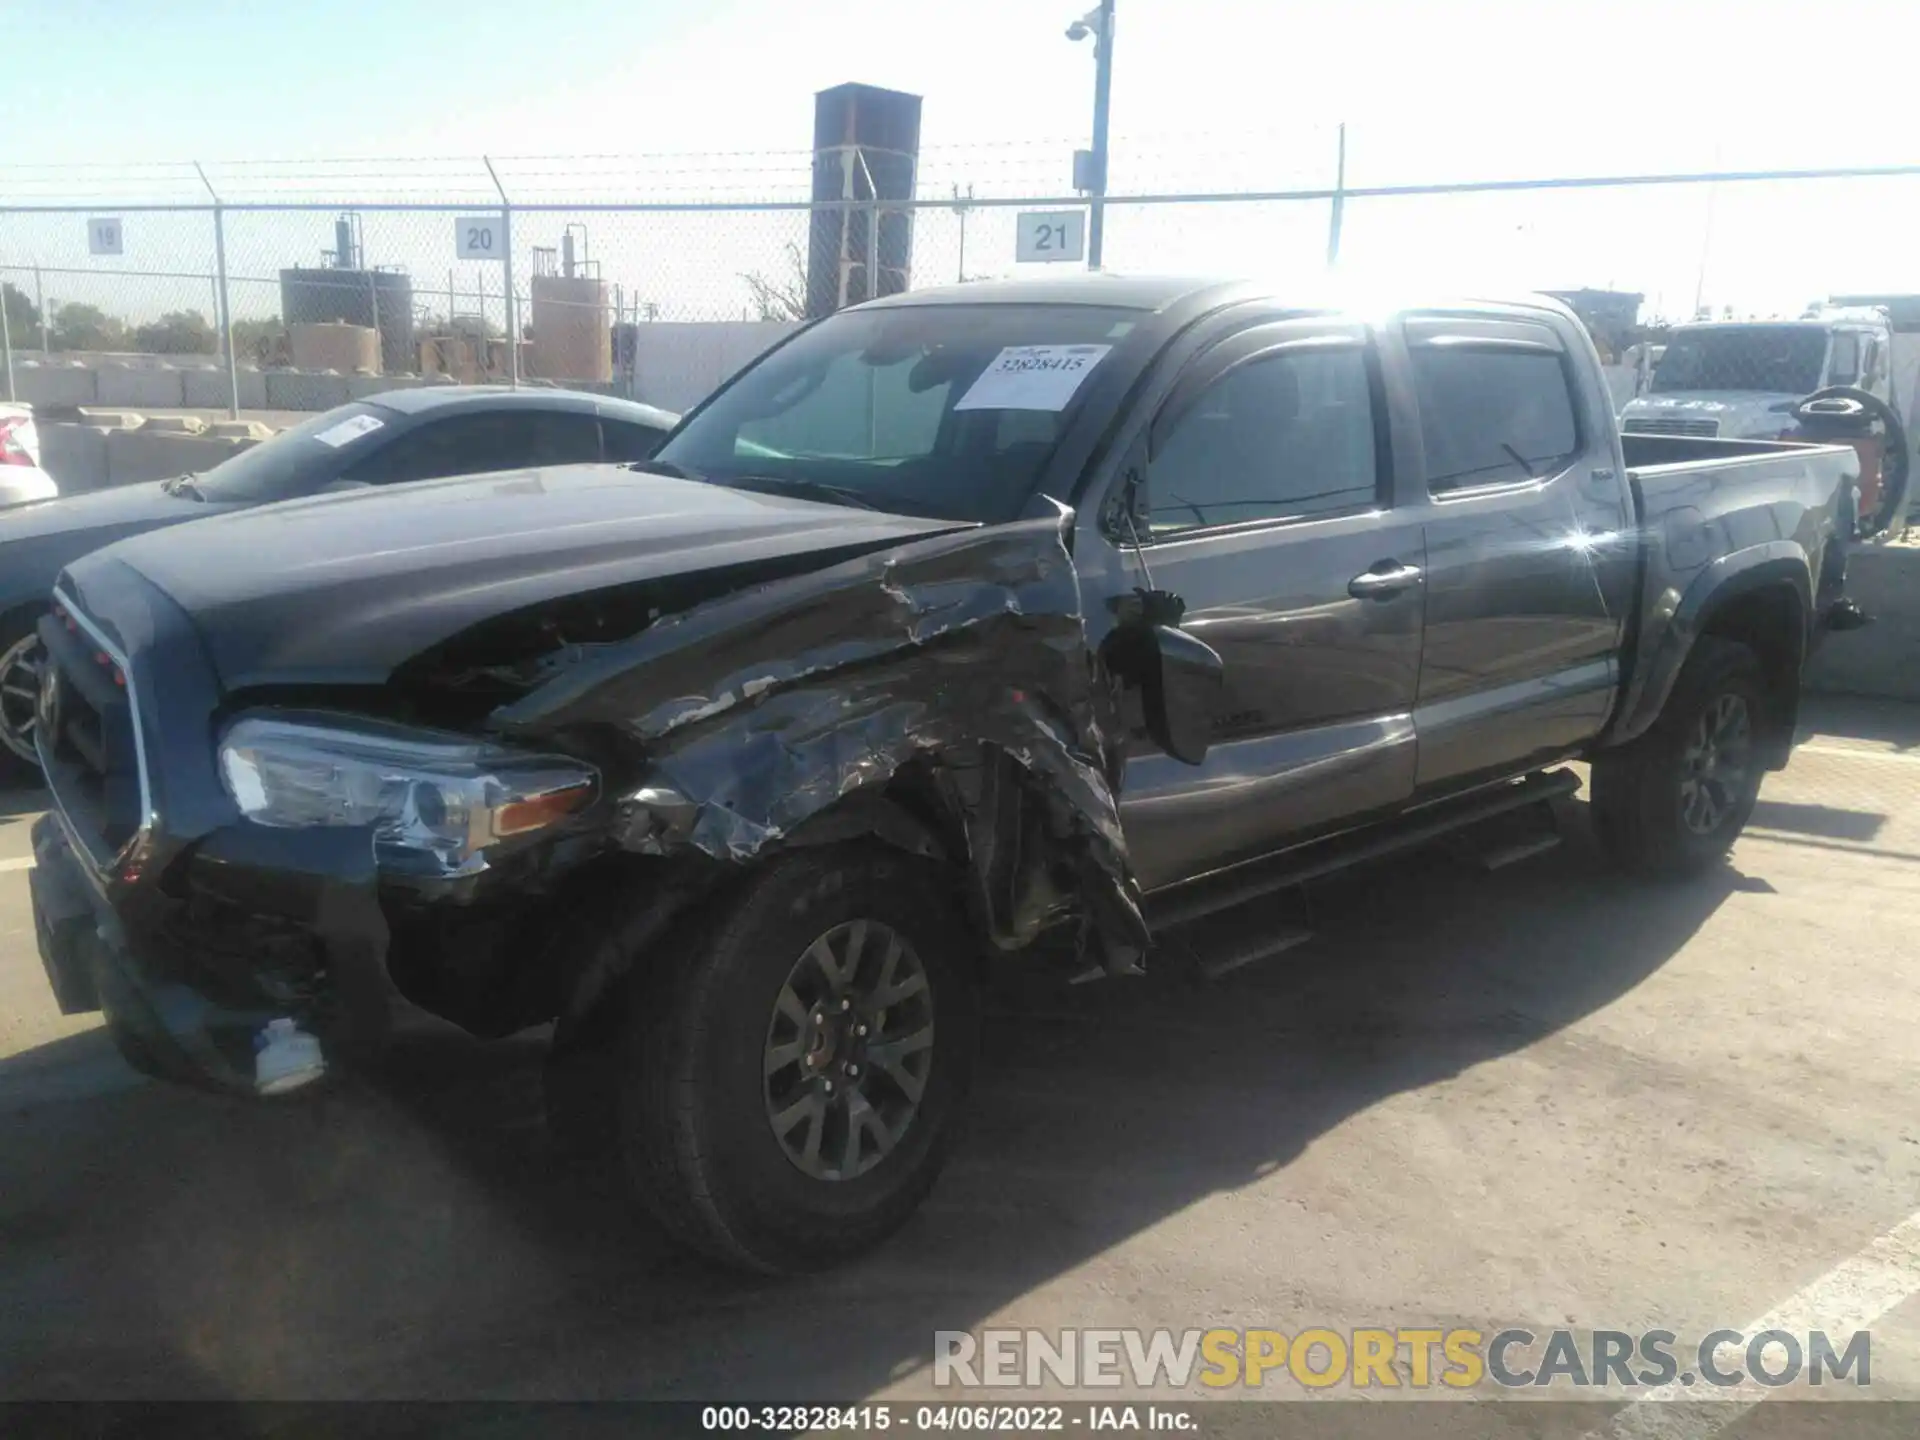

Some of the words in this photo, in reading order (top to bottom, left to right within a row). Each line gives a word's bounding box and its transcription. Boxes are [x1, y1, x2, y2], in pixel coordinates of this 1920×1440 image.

[467, 227, 492, 250] 20
[1034, 224, 1066, 251] 21
[994, 357, 1087, 374] 32828415
